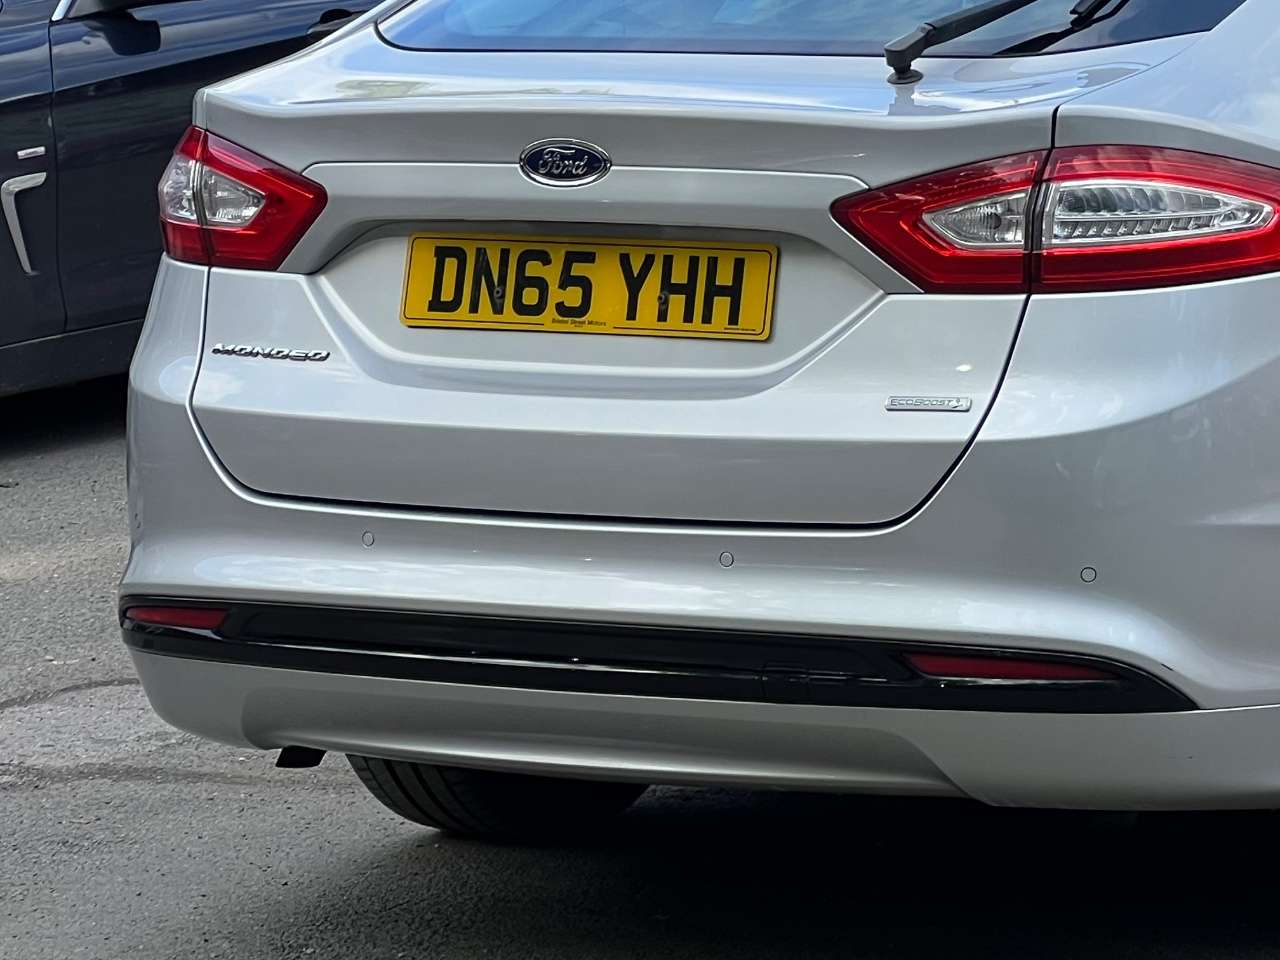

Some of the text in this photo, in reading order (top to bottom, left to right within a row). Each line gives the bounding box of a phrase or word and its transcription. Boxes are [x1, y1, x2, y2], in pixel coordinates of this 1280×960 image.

[537, 148, 588, 176] Ford
[427, 245, 746, 326] DN65 YHH
[211, 343, 331, 362] MONDEO
